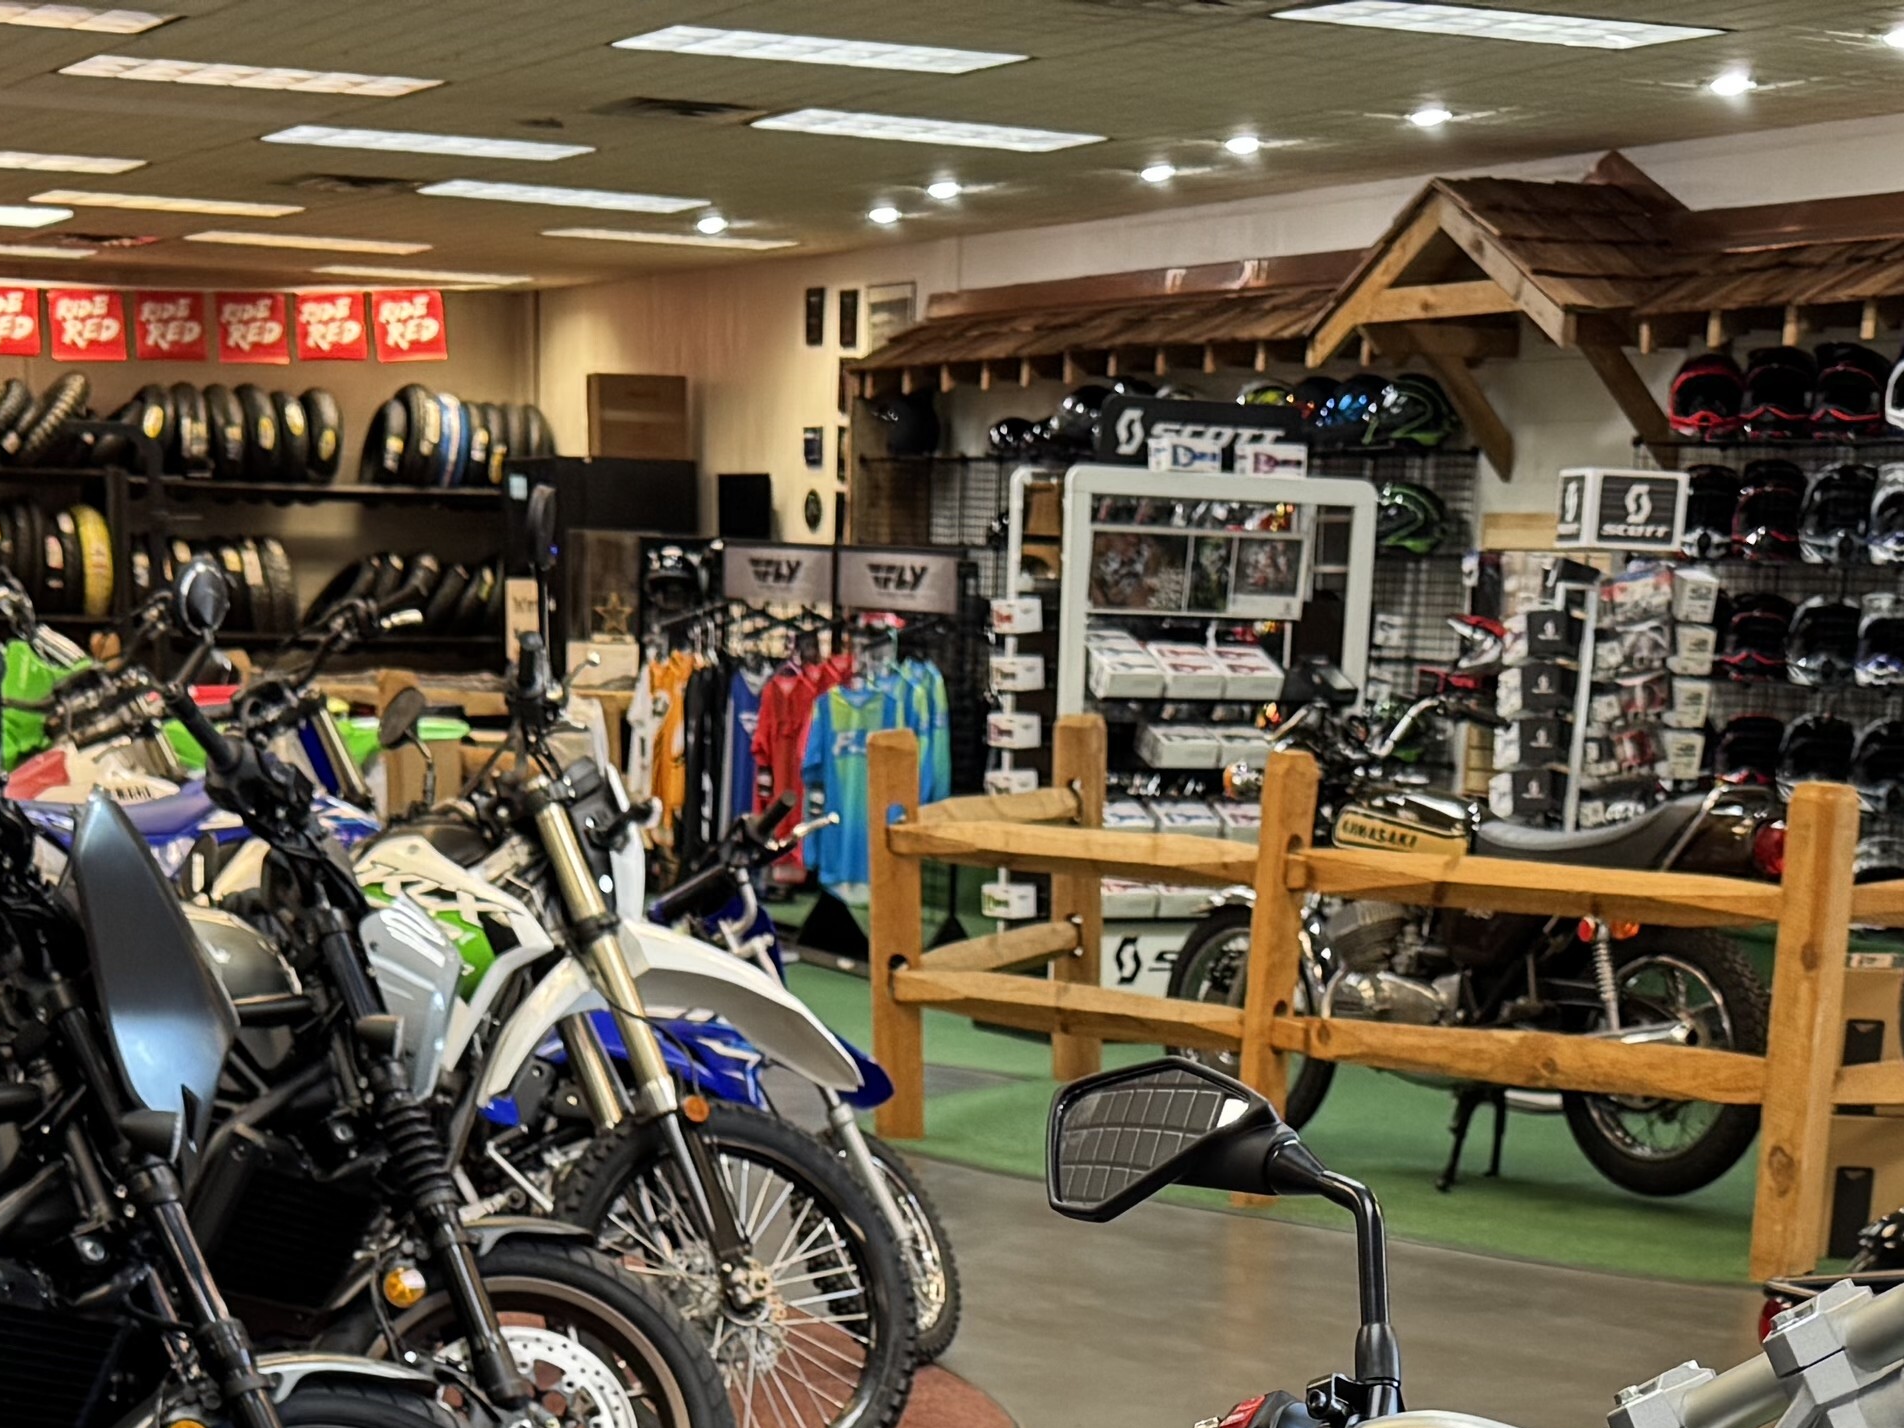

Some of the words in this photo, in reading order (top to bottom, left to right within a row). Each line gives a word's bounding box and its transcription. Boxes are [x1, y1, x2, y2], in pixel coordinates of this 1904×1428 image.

[54, 294, 109, 321] RIDE
[61, 317, 120, 348] RED
[146, 320, 201, 351] RED
[227, 320, 283, 352] RED
[306, 319, 362, 351] RED
[386, 317, 439, 351] RED
[1601, 524, 1670, 538] SCOTT
[749, 558, 801, 584] FLY
[867, 564, 928, 590] FLY
